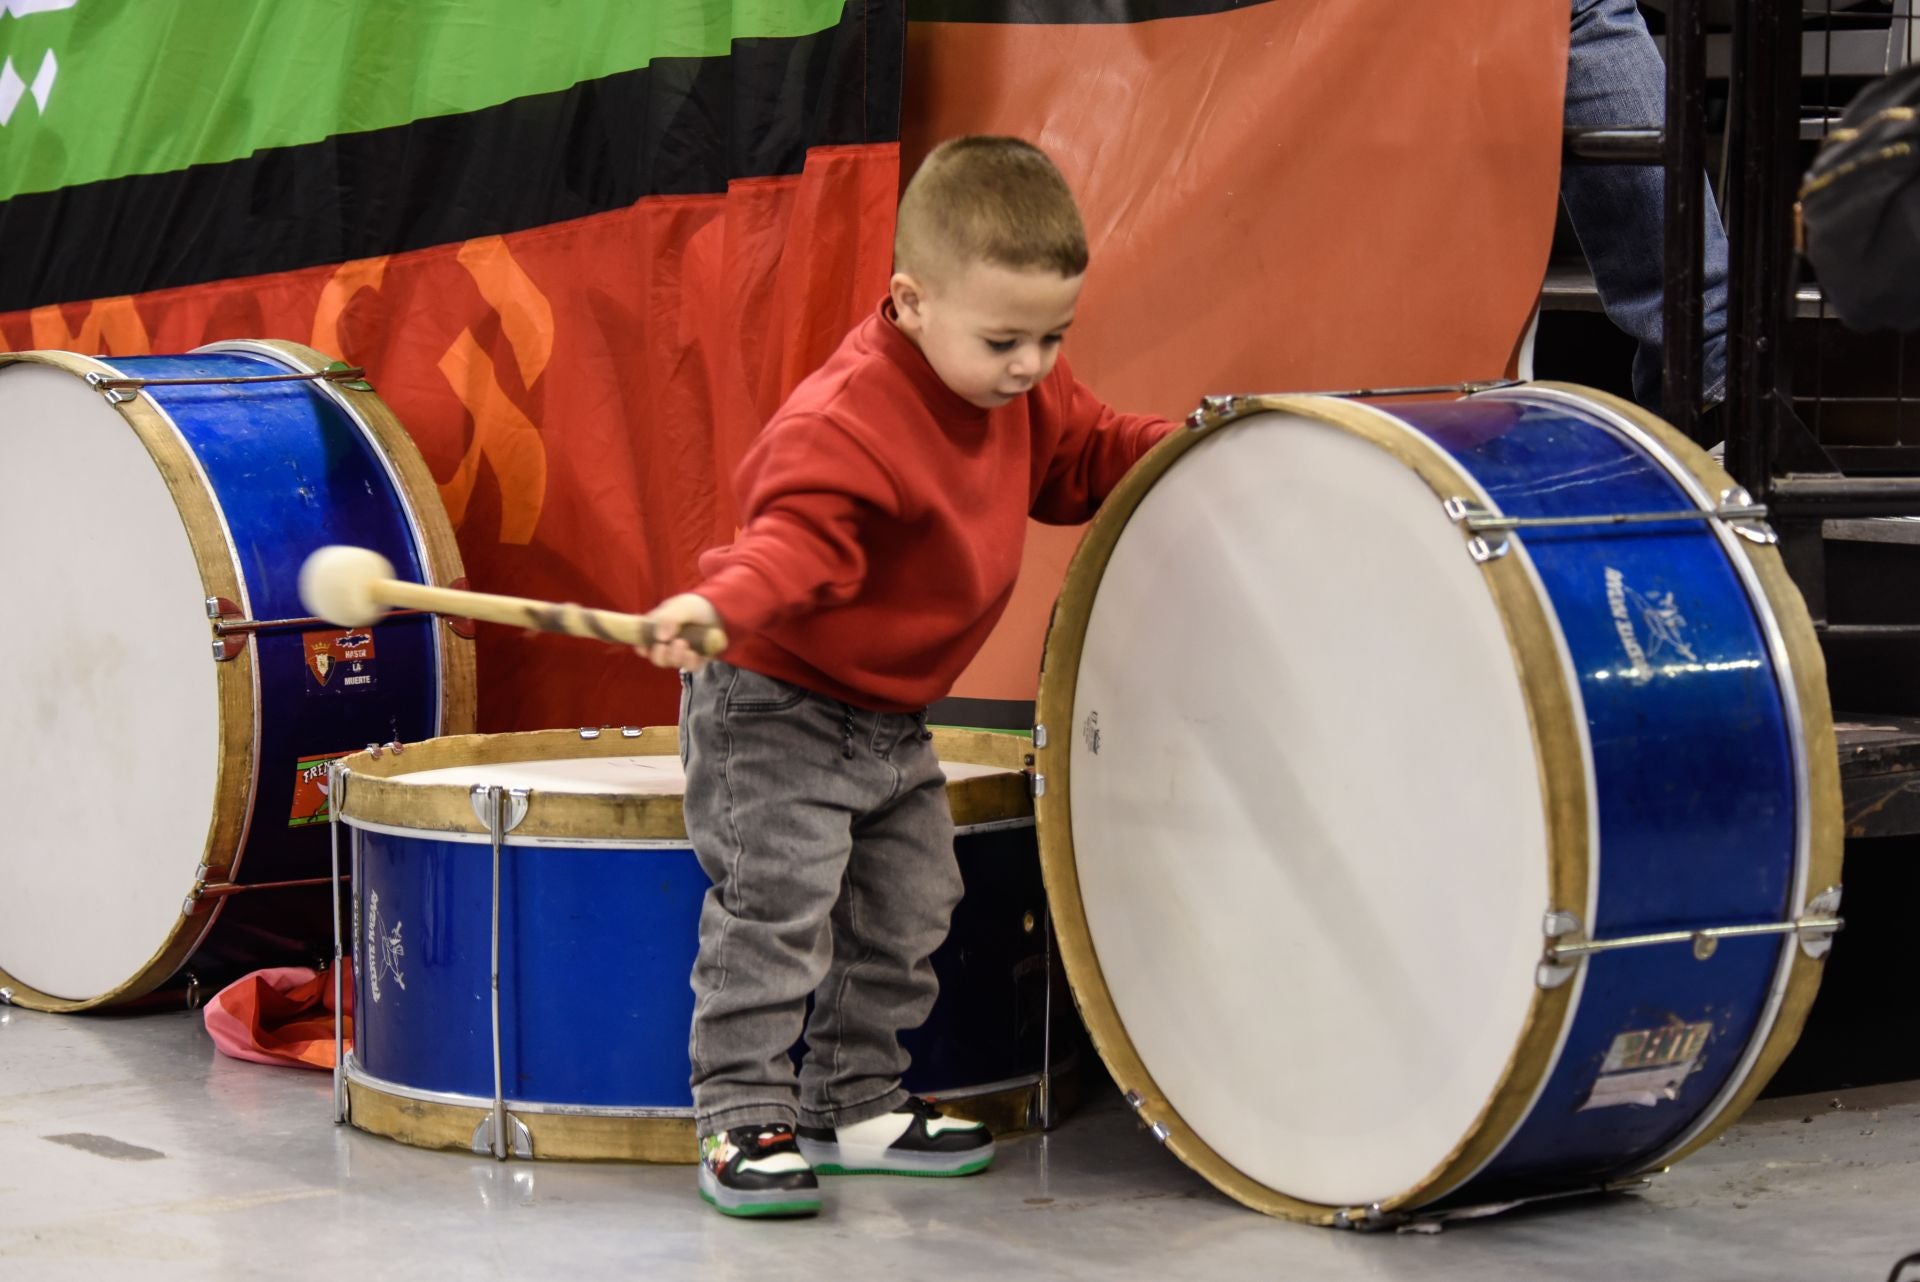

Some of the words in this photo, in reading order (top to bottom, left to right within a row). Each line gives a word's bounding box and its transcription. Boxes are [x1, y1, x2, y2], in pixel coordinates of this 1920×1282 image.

[344, 648, 367, 659] HASTA
[352, 662, 362, 672] LA
[344, 675, 371, 686] MUERTE
